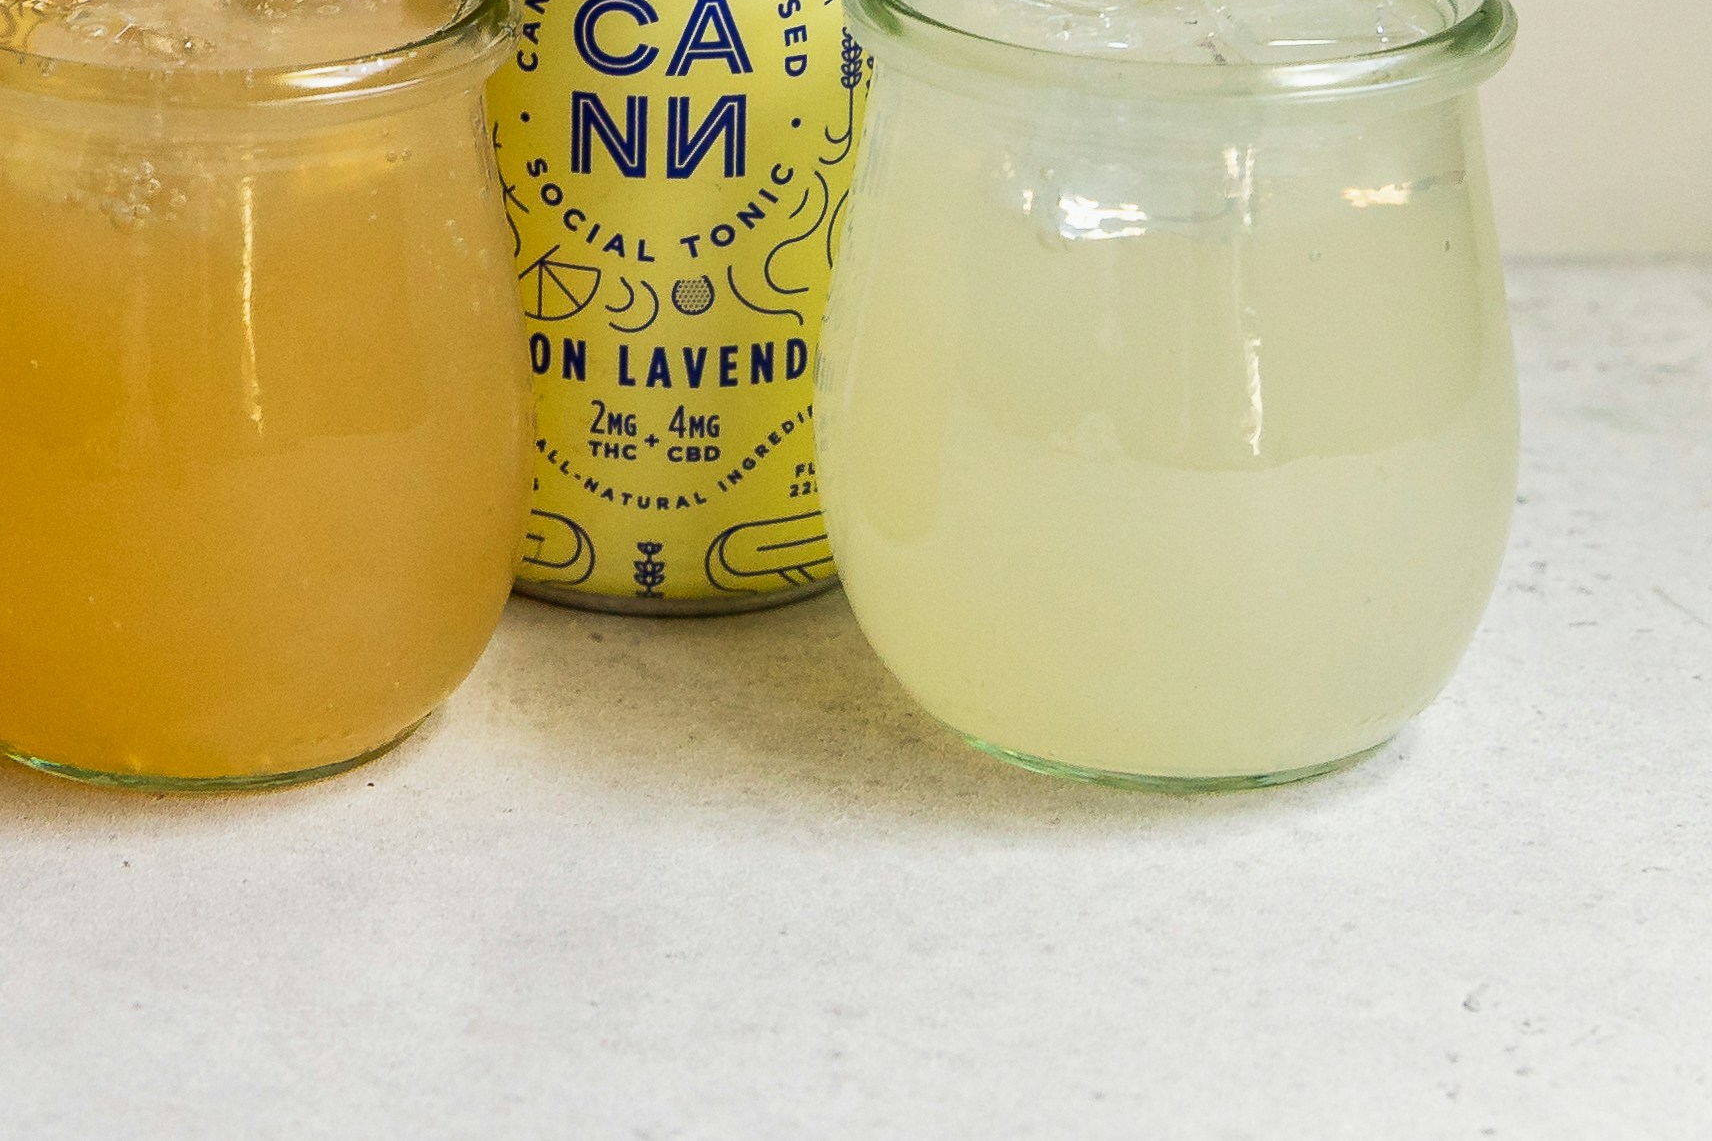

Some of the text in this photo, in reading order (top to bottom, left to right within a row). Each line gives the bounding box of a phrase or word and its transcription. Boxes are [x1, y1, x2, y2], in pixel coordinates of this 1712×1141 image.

[527, 158, 794, 261] SOCIAL TONIC
[529, 332, 808, 388] ON LAVEND
[590, 399, 637, 436] 2MG
[668, 405, 721, 439] 4MG
[535, 438, 707, 511] ALL-NATURAL
[588, 440, 722, 463] THC CBD
